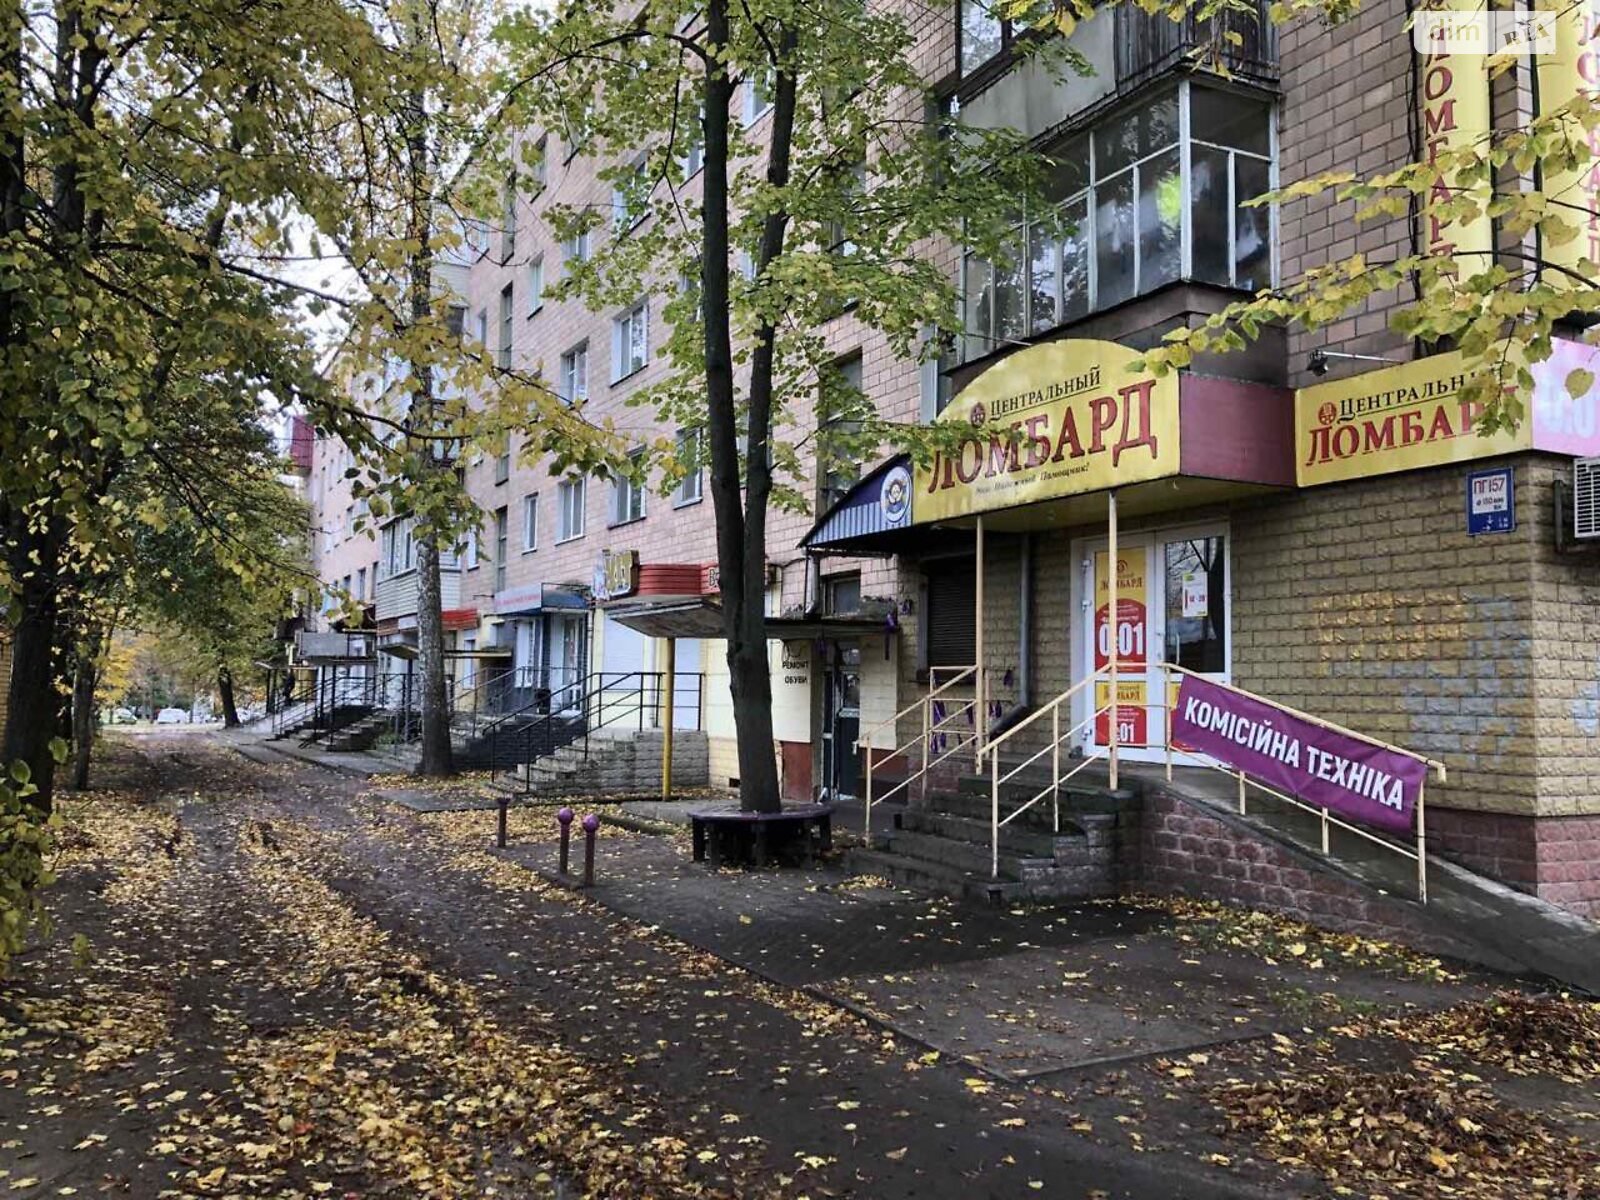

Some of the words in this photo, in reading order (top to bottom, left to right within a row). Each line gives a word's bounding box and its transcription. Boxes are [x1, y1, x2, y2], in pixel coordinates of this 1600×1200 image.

[990, 364, 1101, 421] ЦЕНТРАЛЬНЫЙ
[1337, 366, 1500, 424] ЦЕНТРАЛЬН
[928, 380, 1158, 493] ЛОМБАРД
[1306, 386, 1519, 466] ЛОМБАР
[1101, 577, 1142, 590] ЛБАРД
[1100, 622, 1143, 656] 001
[1185, 696, 1300, 768] КОМІСІЙНА
[1306, 745, 1404, 811] ТЕХНІКА
